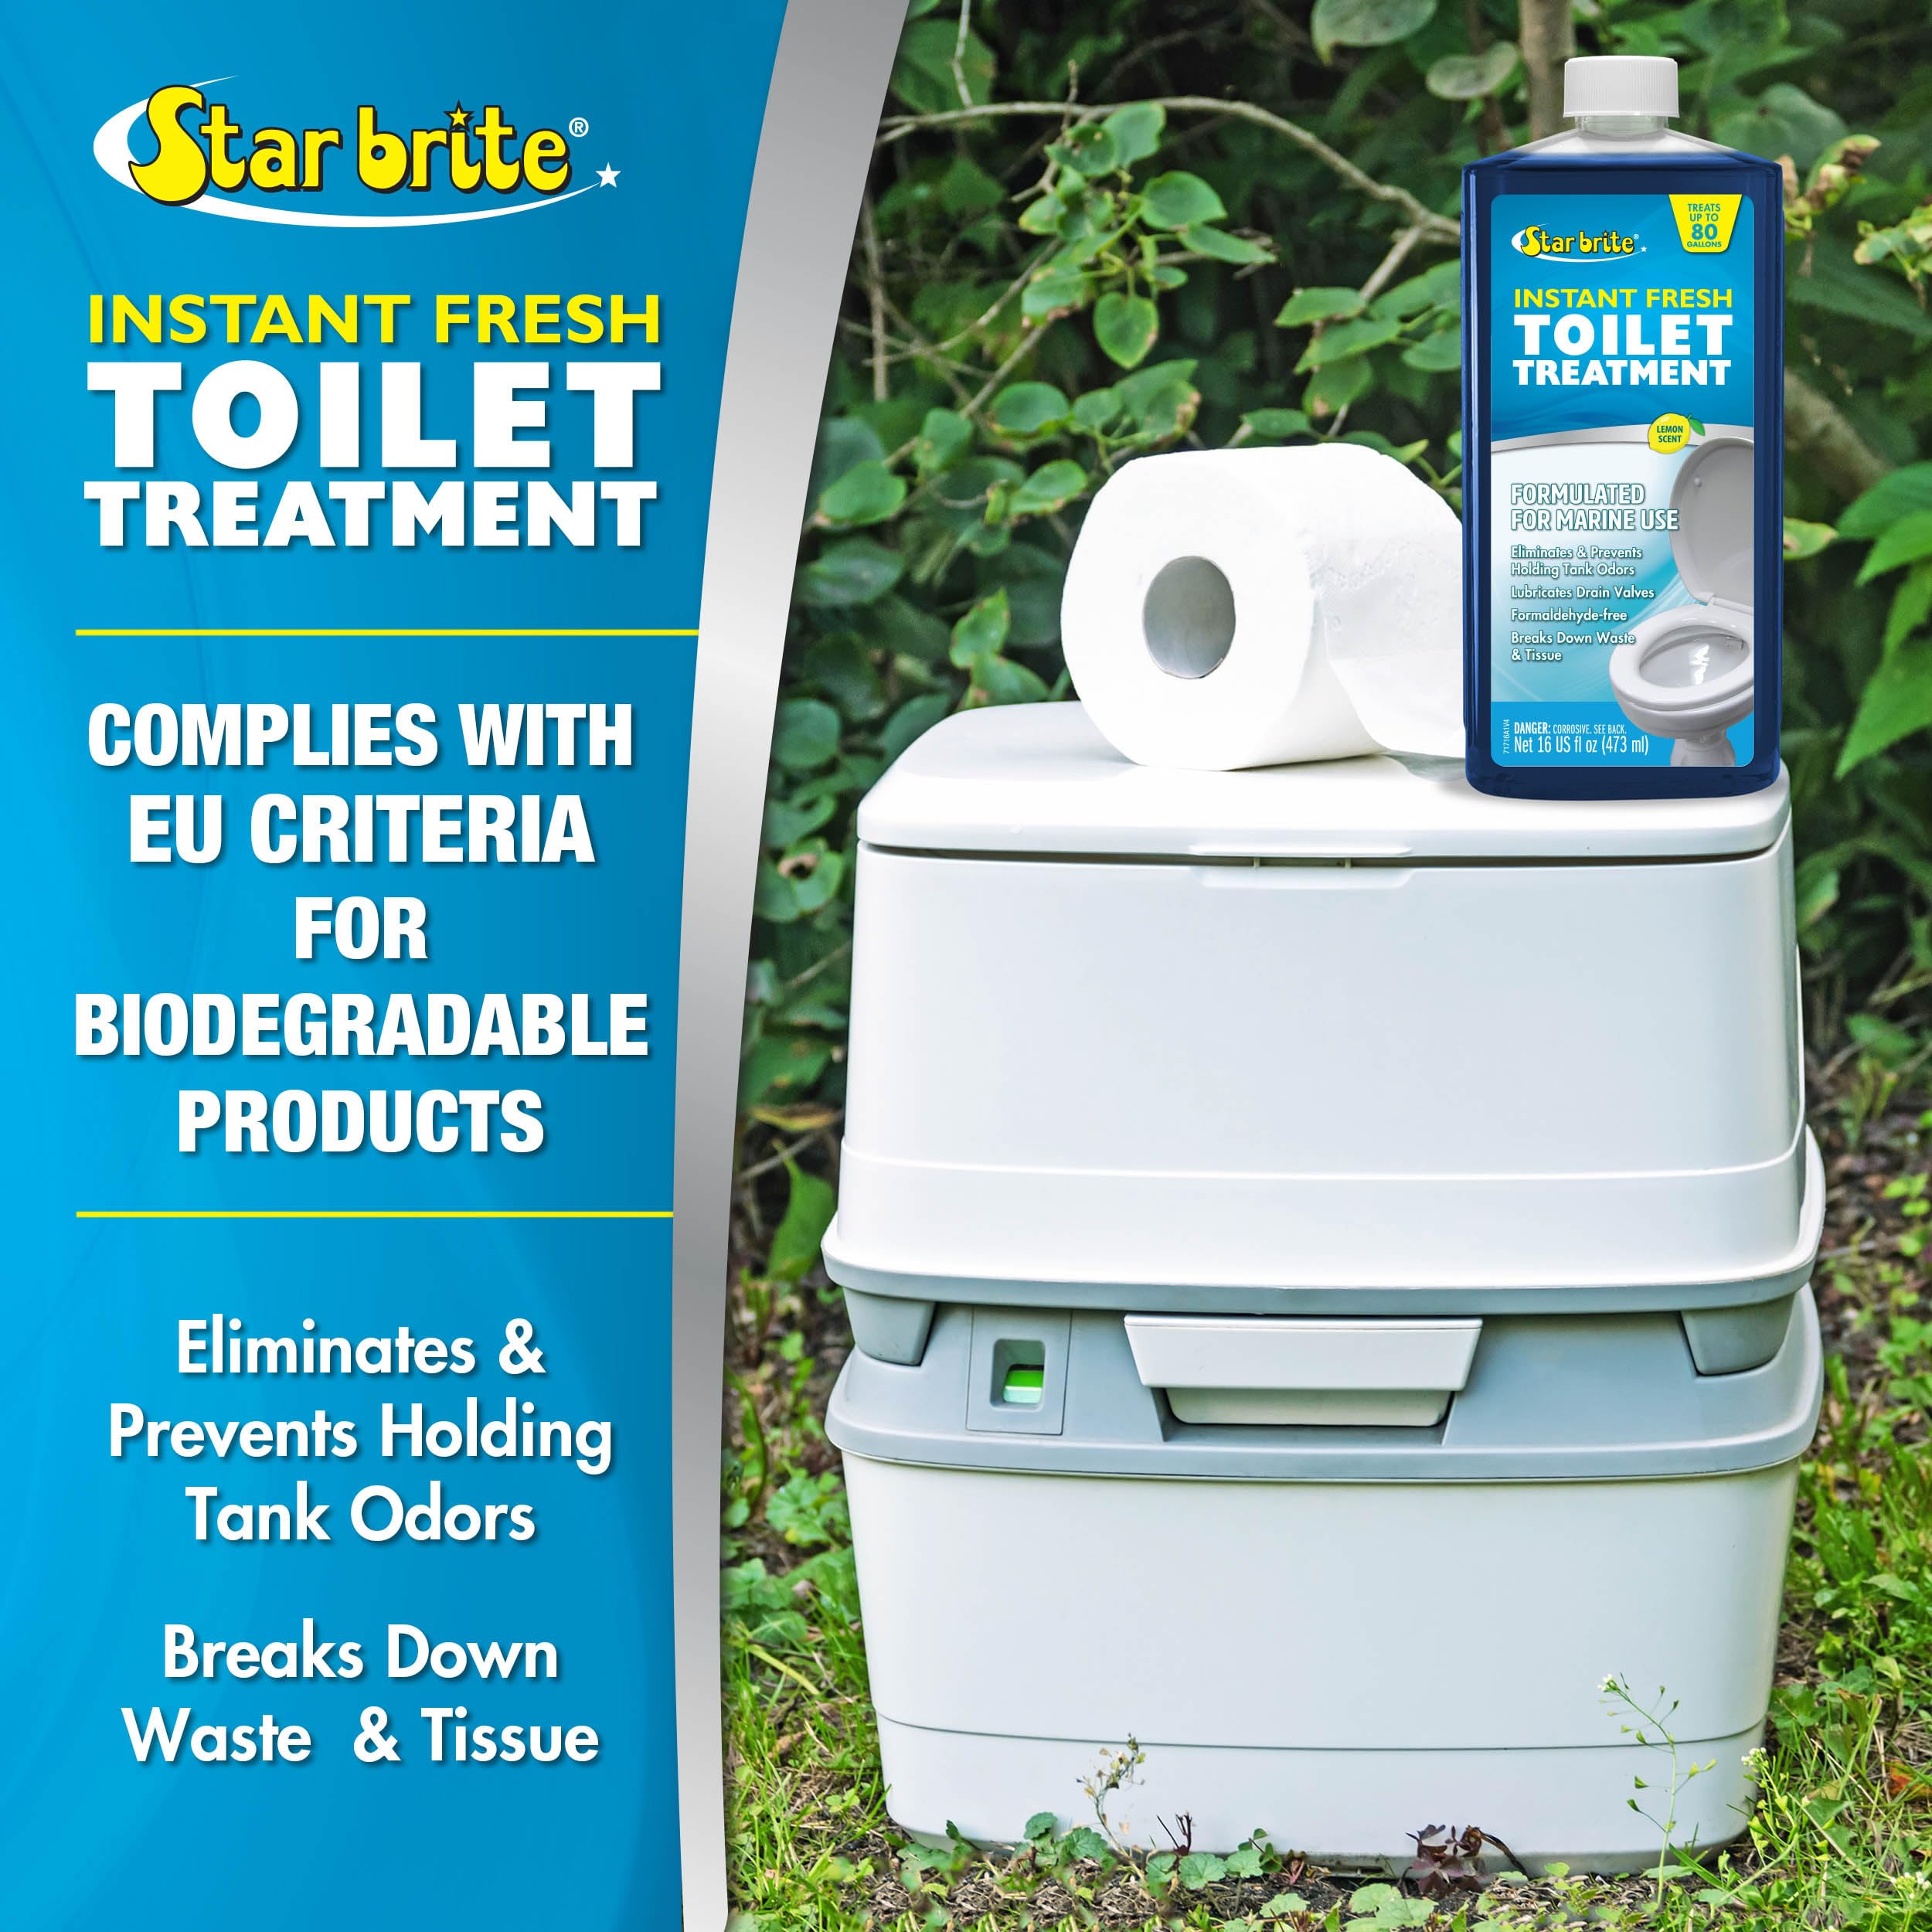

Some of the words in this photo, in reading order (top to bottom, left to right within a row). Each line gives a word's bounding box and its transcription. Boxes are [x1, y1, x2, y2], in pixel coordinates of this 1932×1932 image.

[1688, 203, 1721, 212] TREATS
[1689, 213, 1702, 222] UP
[1706, 213, 1719, 222] TO
[1691, 223, 1718, 240] 80
[1520, 226, 1576, 257] Star
[1514, 288, 1638, 308] INSTANT
[1646, 288, 1733, 308] FRESH
[1513, 313, 1733, 356] TOILET
[1512, 359, 1732, 386] TREATMENT
[1656, 425, 1683, 434] LEMON
[1658, 434, 1682, 443] SCENT
[1510, 483, 1645, 505] FORMULATED
[1510, 509, 1550, 530] FOR
[1556, 509, 1635, 530] MARINE
[1640, 509, 1679, 531] USE
[1511, 545, 1573, 559] Eliminates
[1577, 546, 1587, 559] &
[1590, 546, 1642, 559] Prevents
[1511, 563, 1560, 579] Holding
[1563, 563, 1594, 576] Tank
[1597, 563, 1634, 576] Odors
[1511, 585, 1572, 599] Lubricates
[1576, 585, 1610, 599] Drain
[1614, 585, 1655, 599] Valves
[1511, 607, 1628, 624] Formaldehyde-free
[1511, 631, 1553, 645] Breaks
[1556, 631, 1593, 645] Down
[1596, 631, 1636, 645] Waste
[1511, 648, 1522, 662] &
[1525, 648, 1563, 662] Tissue
[1514, 722, 1551, 734] DANGER:
[1553, 724, 1592, 734] CORROSIVE.
[1594, 724, 1606, 734] SEE
[1607, 724, 1627, 734] BACK.
[1514, 736, 1533, 753] Net
[1537, 736, 1552, 753] 16
[1556, 736, 1571, 753] US
[1574, 736, 1582, 753] fl
[1585, 740, 1597, 753] oz
[1601, 735, 1628, 756] (473
[1631, 735, 1649, 756] ml)
